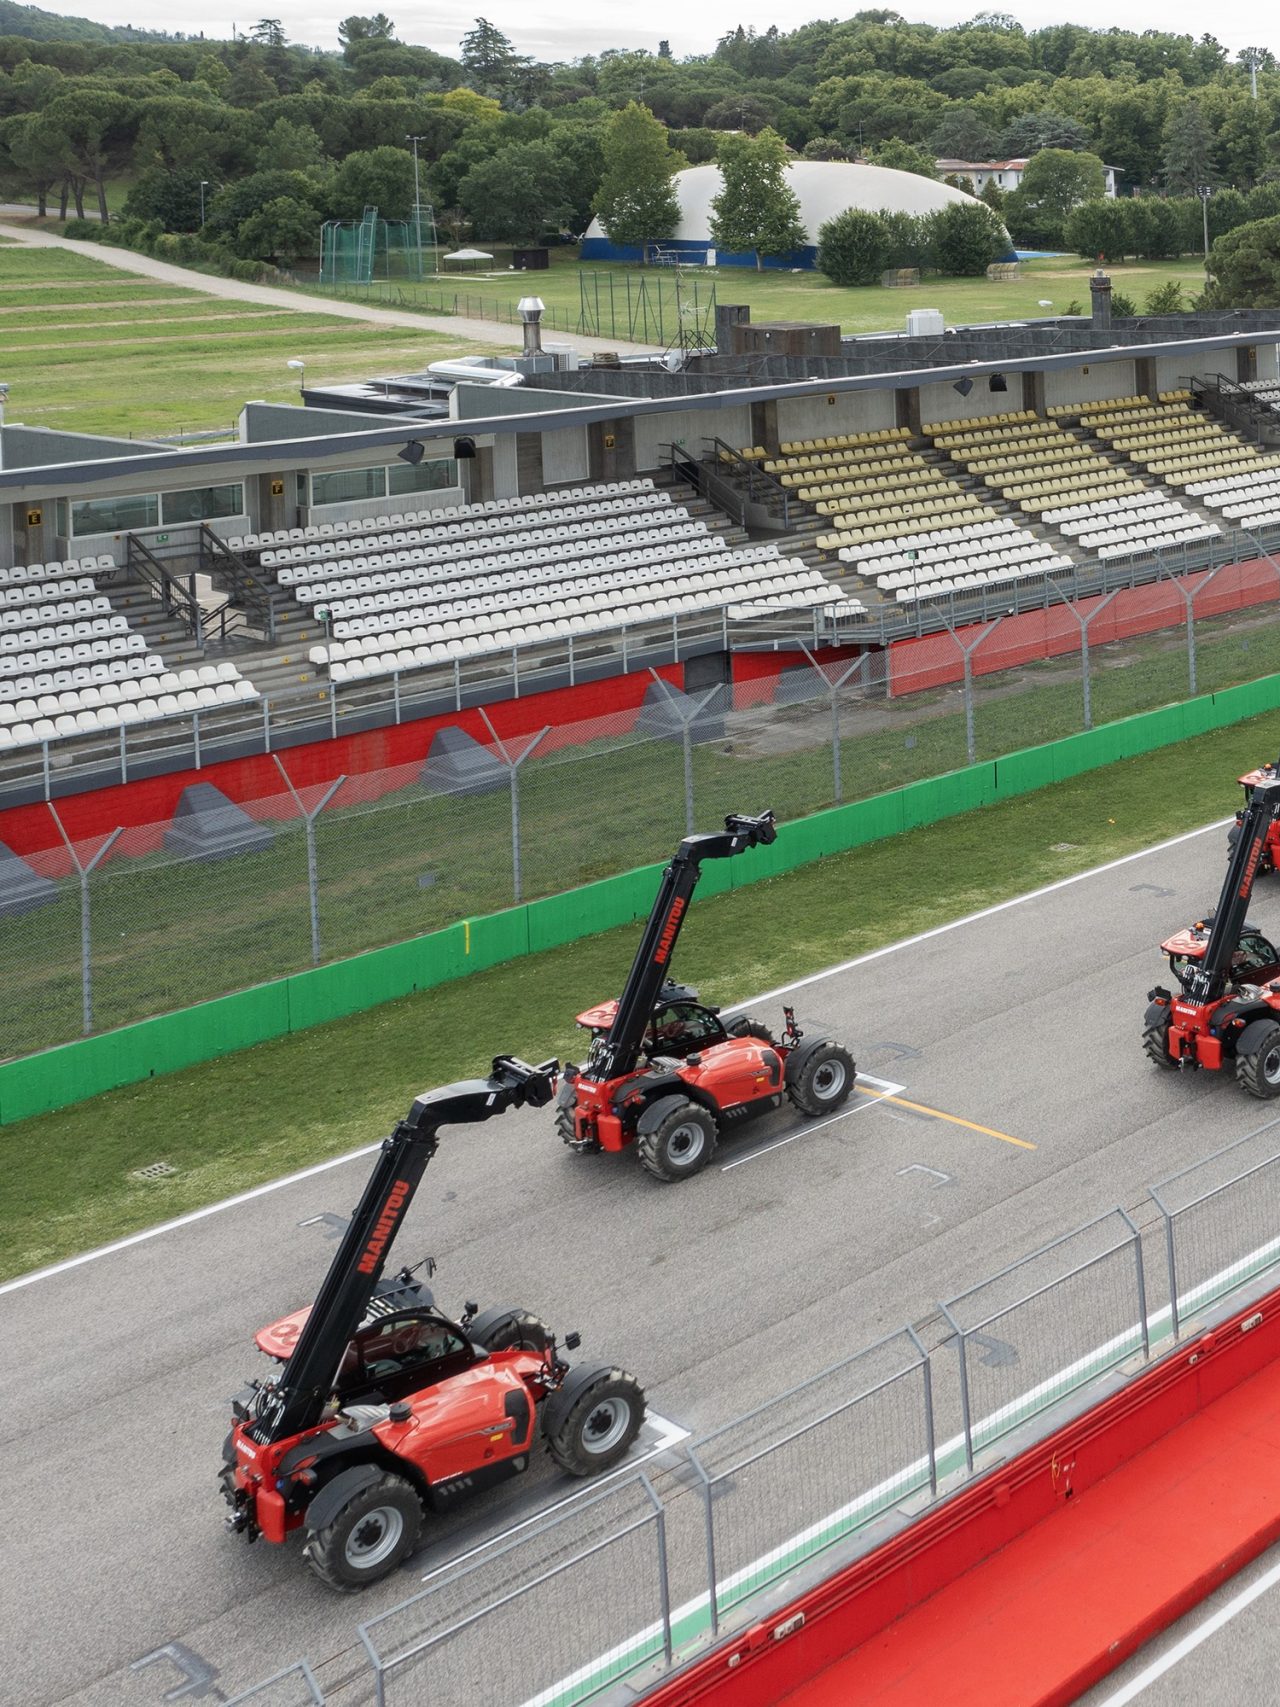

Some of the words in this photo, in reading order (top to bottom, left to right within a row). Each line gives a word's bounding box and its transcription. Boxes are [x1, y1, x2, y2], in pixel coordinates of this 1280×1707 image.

[1239, 837, 1262, 898] MANITOU
[654, 896, 685, 964] MANITOU
[356, 1179, 410, 1274] MANITOU
